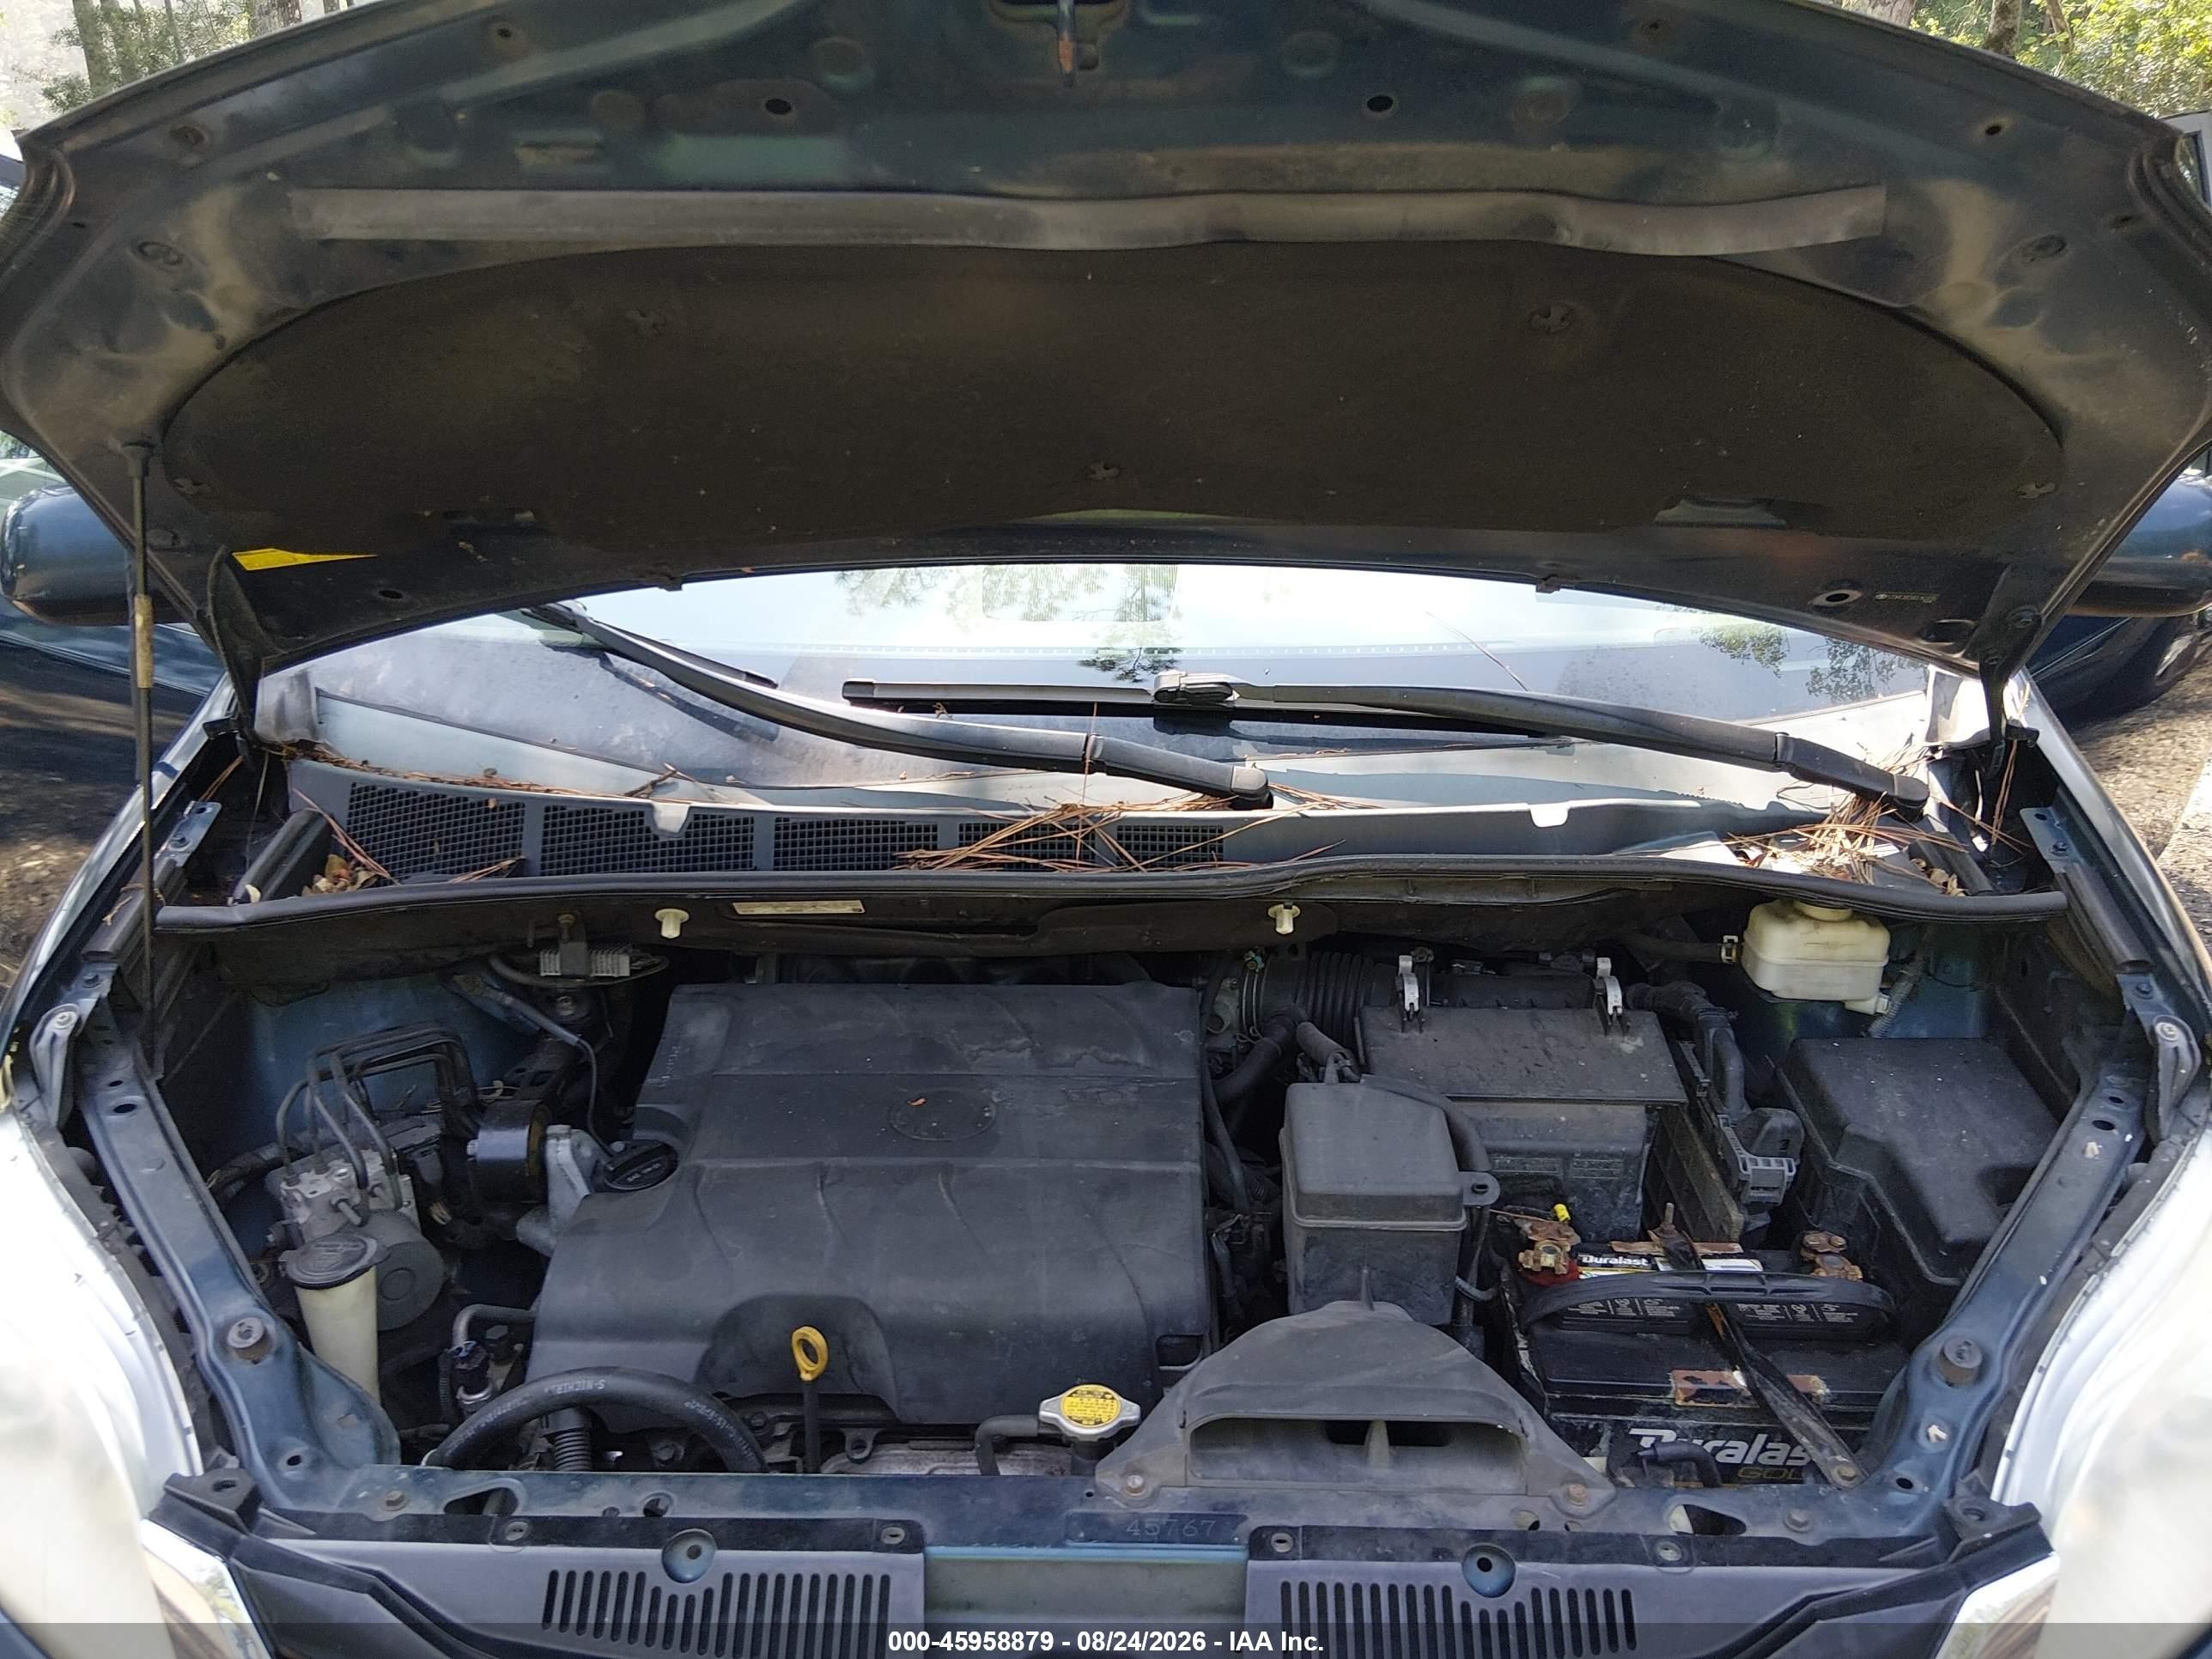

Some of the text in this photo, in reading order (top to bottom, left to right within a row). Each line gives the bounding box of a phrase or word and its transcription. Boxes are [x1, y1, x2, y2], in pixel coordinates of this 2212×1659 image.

[1578, 1254, 1649, 1267] Duralast
[1737, 1467, 1803, 1480] GOL
[1126, 1518, 1216, 1537] 45767
